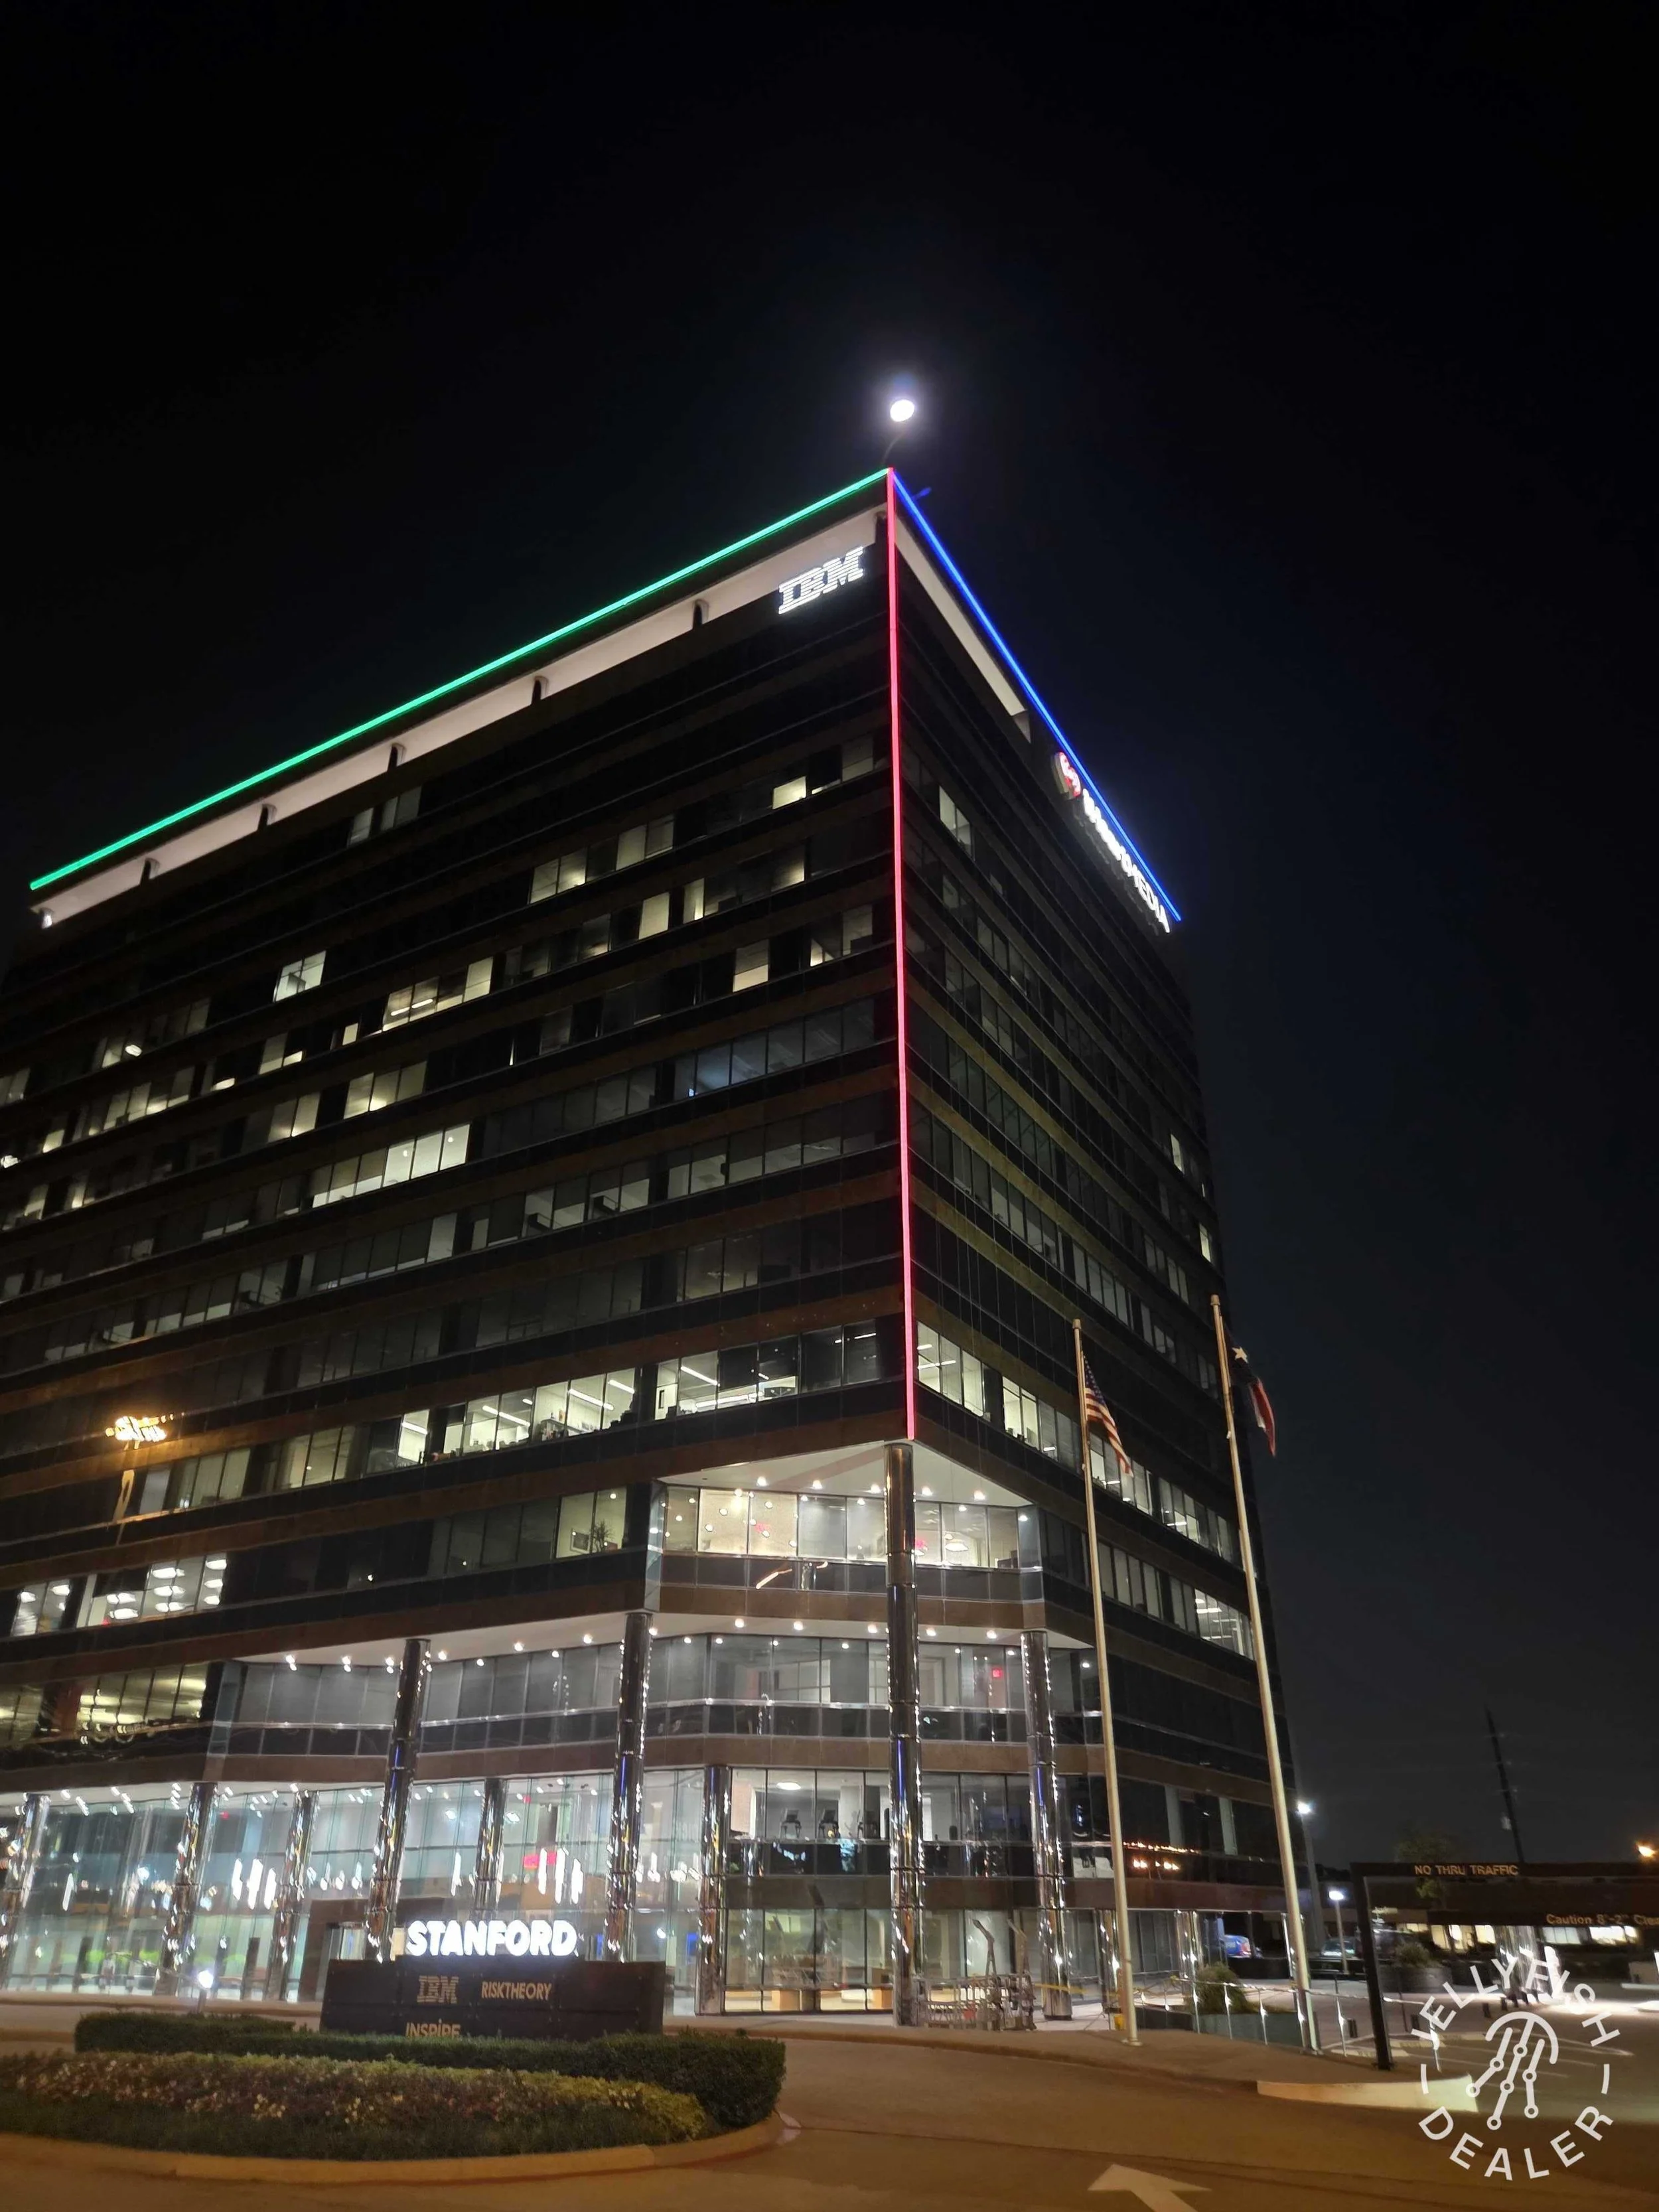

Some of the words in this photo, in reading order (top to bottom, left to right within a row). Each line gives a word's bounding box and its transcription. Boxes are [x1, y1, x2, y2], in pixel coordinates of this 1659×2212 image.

[778, 546, 863, 615] IBM
[1414, 1865, 1431, 1875] NO
[1435, 1865, 1466, 1875] THRU
[1470, 1864, 1519, 1876] TRAFFIC
[1546, 1913, 1592, 1924] Caution
[407, 1920, 577, 1956] STANFORD
[417, 1975, 459, 2004] IBM
[481, 1980, 552, 2001] RISKTHEORY
